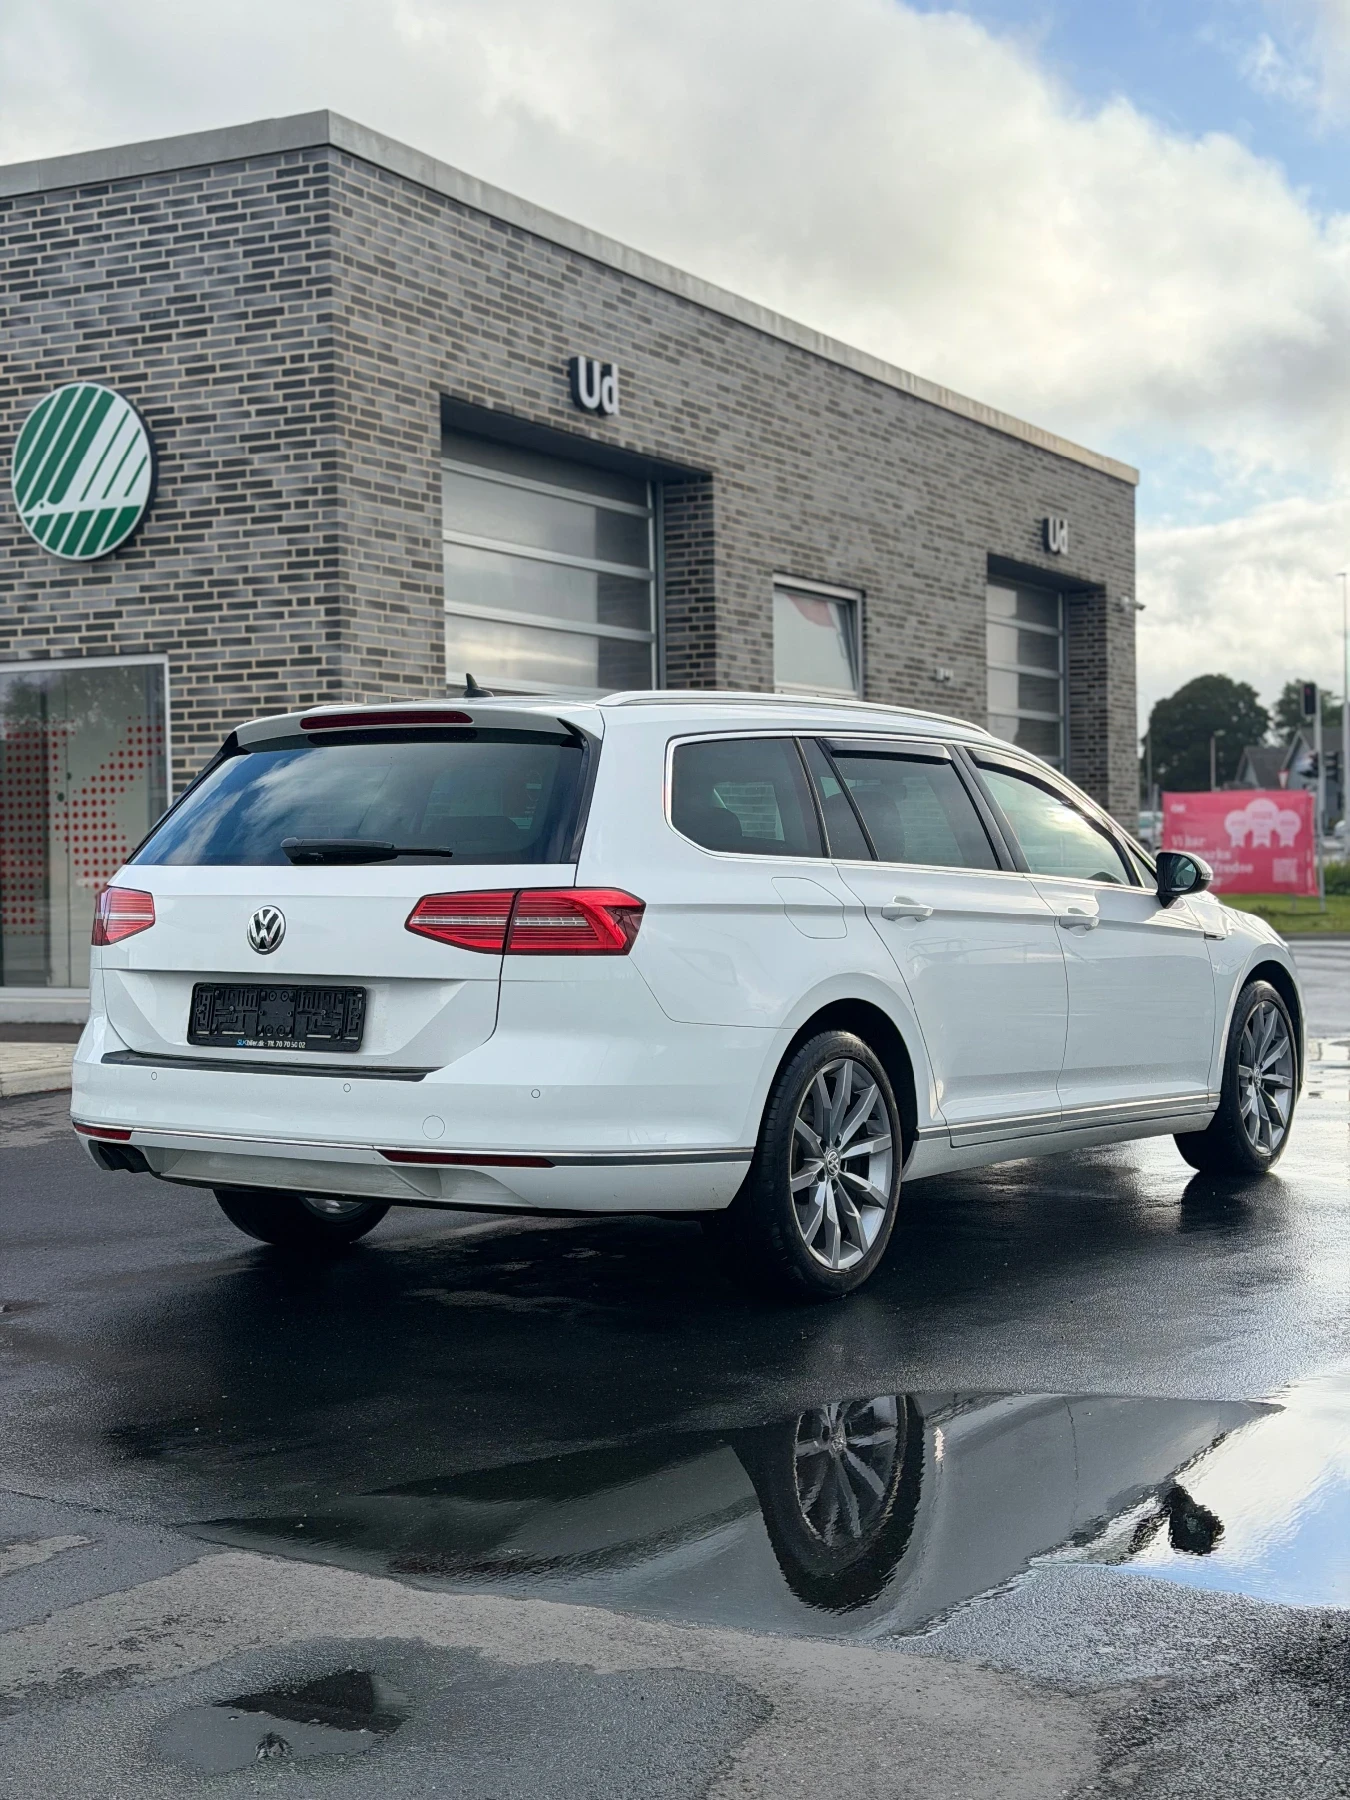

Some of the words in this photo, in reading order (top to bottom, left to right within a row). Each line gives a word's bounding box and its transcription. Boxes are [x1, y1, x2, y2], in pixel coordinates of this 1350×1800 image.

[576, 355, 619, 415] Ud
[1047, 516, 1068, 555] Ud
[248, 906, 285, 954] VW
[275, 1040, 283, 1048] 70
[283, 1040, 291, 1048] 70
